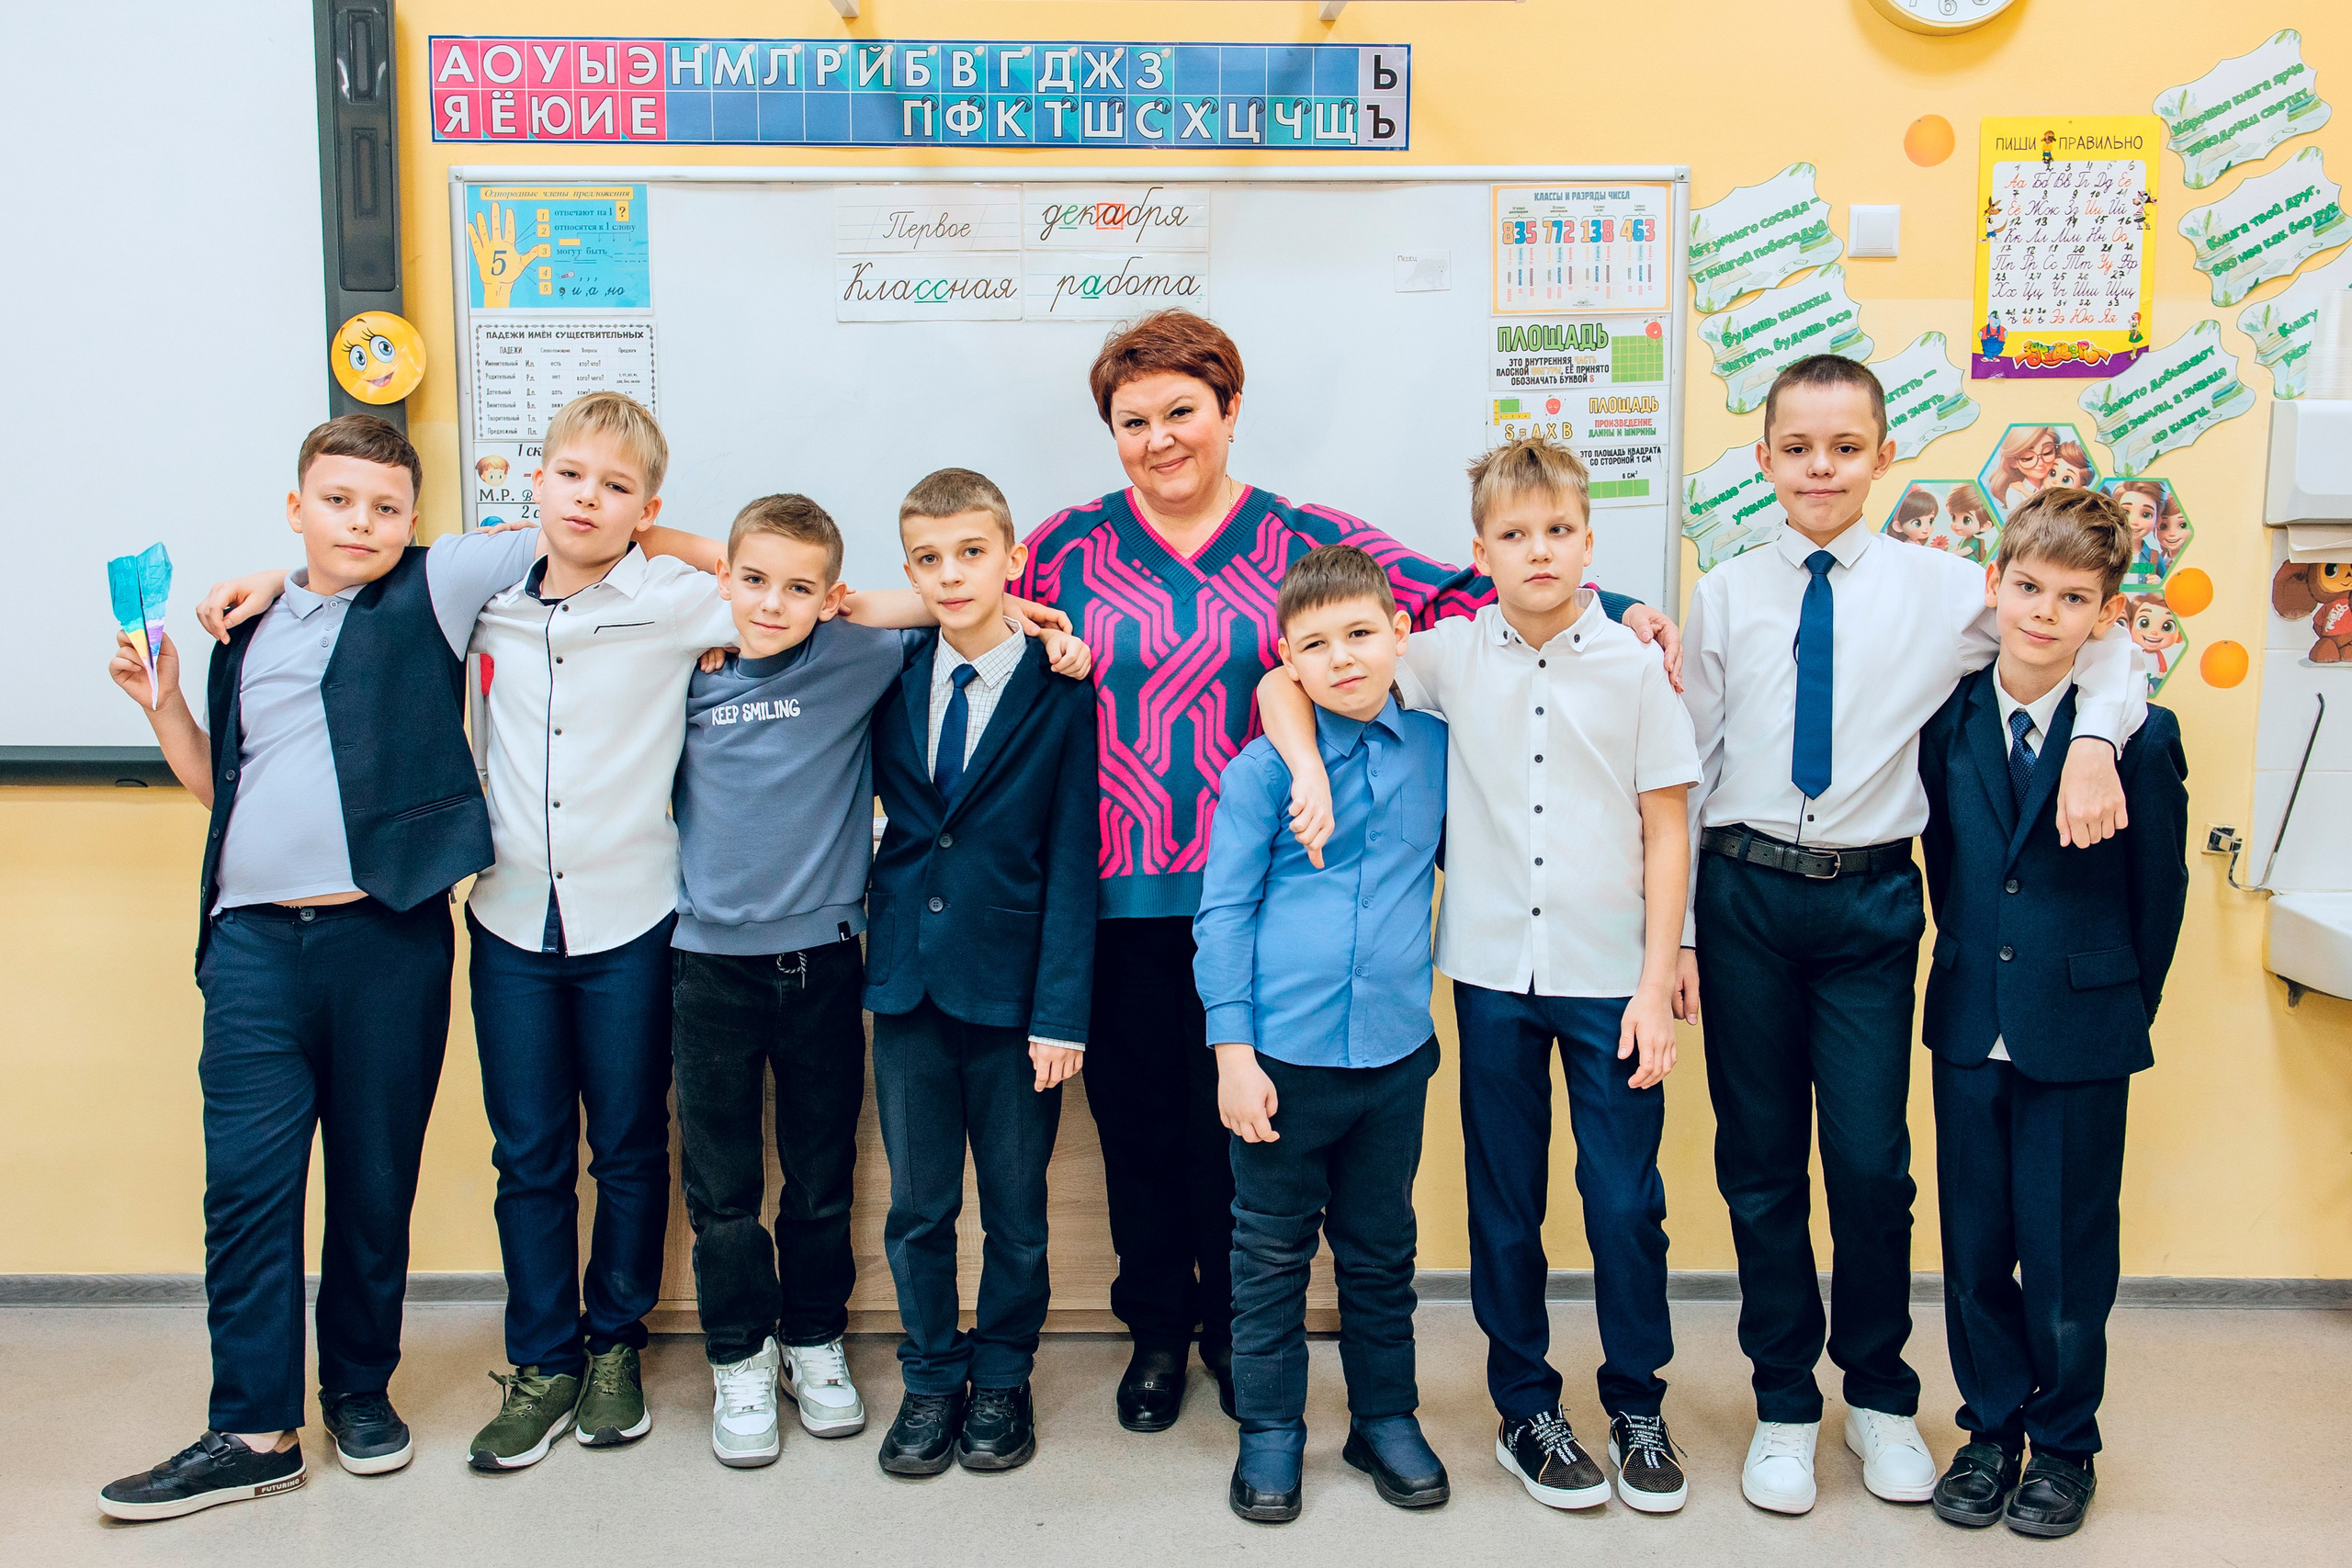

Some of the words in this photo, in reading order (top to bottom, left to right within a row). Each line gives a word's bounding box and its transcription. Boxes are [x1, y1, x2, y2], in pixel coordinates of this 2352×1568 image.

[438, 45, 475, 83] А
[482, 45, 523, 84] О
[533, 46, 565, 84] У
[580, 47, 615, 85] Ы
[628, 47, 658, 85] Э
[672, 49, 703, 85] Н
[713, 49, 755, 86] М
[763, 49, 796, 86] Л
[816, 49, 841, 86] Р
[859, 45, 891, 87] Й
[906, 50, 932, 87] Б
[953, 51, 977, 88] В
[1000, 51, 1023, 87] Г
[1037, 51, 1075, 94] Д
[1082, 51, 1125, 88] Ж
[1136, 51, 1163, 89] З
[1374, 55, 1397, 90] Ь
[2171, 99, 2232, 136] Хорошая
[2232, 78, 2272, 106] книга
[2273, 62, 2304, 85] ярче
[443, 96, 469, 133] Я
[491, 91, 516, 134] Ё
[531, 96, 572, 135] Ю
[580, 96, 614, 135] И
[632, 97, 656, 135] Е
[904, 100, 933, 137] П
[945, 99, 983, 138] Ф
[998, 101, 1026, 138] К
[1043, 101, 1070, 138] Т
[1084, 101, 1124, 139] Ш
[1136, 102, 1165, 140] С
[1181, 102, 1212, 139] Х
[1229, 103, 1261, 144] Ц
[1274, 103, 1302, 139] Ч
[1316, 103, 1358, 145] Щ
[1367, 104, 1396, 140] Ъ
[2187, 117, 2260, 157] звездочки
[2260, 88, 2308, 118] светит
[1996, 136, 2036, 151] ПИШИ
[2058, 135, 2143, 151] ПРАВИЛЬНО
[484, 189, 538, 197] Однородные
[1534, 192, 1563, 201] КЛАССЫ
[1566, 192, 1570, 200] И
[1572, 191, 1606, 201] РАЗРЯДЫ
[1609, 191, 1630, 200] ЧИСЕЛ
[554, 209, 594, 217] отвечают
[882, 210, 971, 250] Первое
[1039, 186, 1188, 243] декабря
[2206, 222, 2250, 251] Книга
[2250, 202, 2283, 227] твой
[2286, 186, 2321, 213] друг,
[612, 223, 636, 232] слову
[1502, 220, 1537, 244] 835
[1543, 220, 1575, 243] 772
[1580, 220, 1614, 243] 138
[1620, 219, 1656, 243] 463
[1713, 223, 1758, 252] умного
[1760, 200, 1810, 229] соседа
[557, 248, 582, 256] могут
[1695, 272, 1705, 283] с
[1706, 251, 1754, 278] книгой
[1754, 220, 1827, 259] побеседуй
[2212, 257, 2237, 277] без
[2237, 243, 2263, 265] нее
[2263, 230, 2289, 251] как
[2288, 213, 2312, 235] без
[2312, 202, 2339, 224] рук
[491, 250, 507, 276] 5
[843, 262, 1017, 302] Классная
[1049, 256, 1201, 312] работа
[1722, 316, 1777, 347] Будешь
[1779, 291, 1832, 321] книжки
[528, 330, 551, 338] ИМЁН
[1498, 323, 1609, 352] ПЛОЩАДЬ
[1722, 348, 1774, 372] читать,
[1773, 321, 1826, 351] будешь
[1826, 310, 1853, 328] все
[1497, 366, 1529, 377] ПЛОСКОЙ
[1566, 365, 1574, 374] ЕЁ
[1577, 365, 1609, 373] ПРИНЯТО
[1509, 358, 1522, 367] ЭТО
[1525, 356, 1572, 366] ВНУТРЕННЯЯ
[1511, 377, 1557, 386] ОБОЗНАЧАТЬ
[1560, 374, 1588, 384] БУКВОЙ
[1885, 378, 1923, 403] итать
[2098, 386, 2147, 418] Золото
[2150, 345, 2215, 392] добывают
[1589, 396, 1659, 413] ПЛОЩАДЬ
[1891, 413, 1907, 427] не
[1907, 394, 1945, 418] знать
[2111, 425, 2128, 441] из
[2128, 400, 2174, 430] земли,
[2174, 393, 2182, 404] а
[2184, 367, 2227, 398] знания
[1589, 429, 1614, 438] ДЛИНЫ
[1624, 427, 1657, 436] ШИРИНЫ
[1595, 418, 1652, 428] ПРОИЗВЕДЕНИЕ
[2152, 429, 2168, 444] из
[1595, 448, 1625, 457] ПЛОЩАДЬ
[1628, 446, 1661, 456] КВАДРАТА
[1600, 456, 1634, 465] СТОРОНОЙ
[522, 505, 529, 518] 2
[1690, 487, 1739, 515] Чтение
[711, 705, 739, 726] KEEP
[742, 699, 801, 722] SMILING
[262, 1479, 300, 1493] FUTURINO
